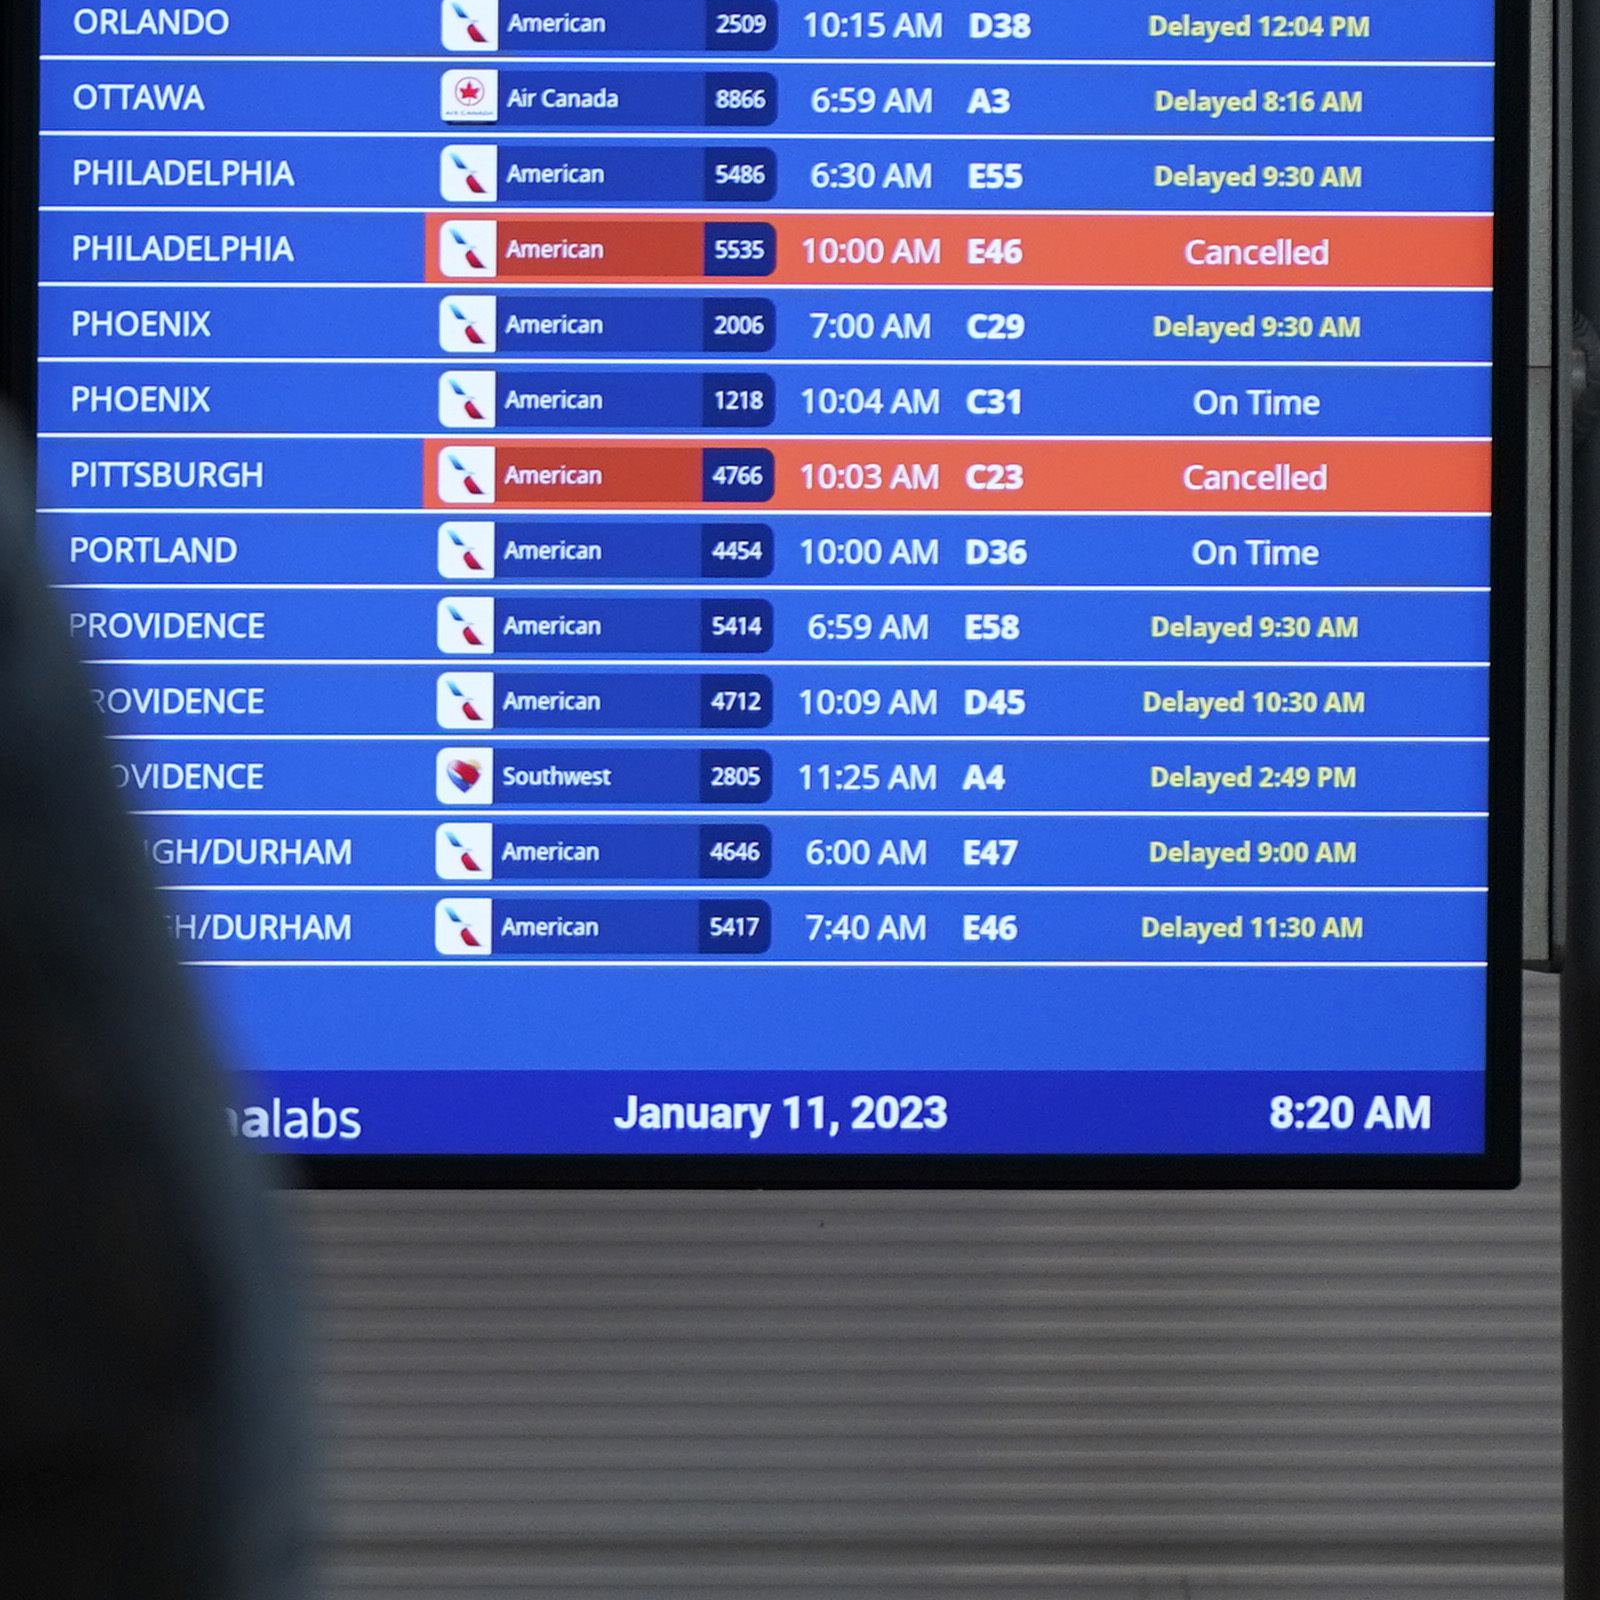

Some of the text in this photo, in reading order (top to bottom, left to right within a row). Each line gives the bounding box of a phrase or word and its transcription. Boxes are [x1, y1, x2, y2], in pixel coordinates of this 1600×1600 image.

[73, 83, 1363, 119] OTTAWA Air Canada 8866 6:59 AM A3 Delayed 8:16 AM
[90, 687, 1365, 720] ROVIDENCE American 4712 10:09 AM D45 Delayed 10:30 AM
[224, 1097, 362, 1140] alabs
[613, 1094, 948, 1139] January 11, 2023
[1269, 1095, 1431, 1130] 8:20 AM
